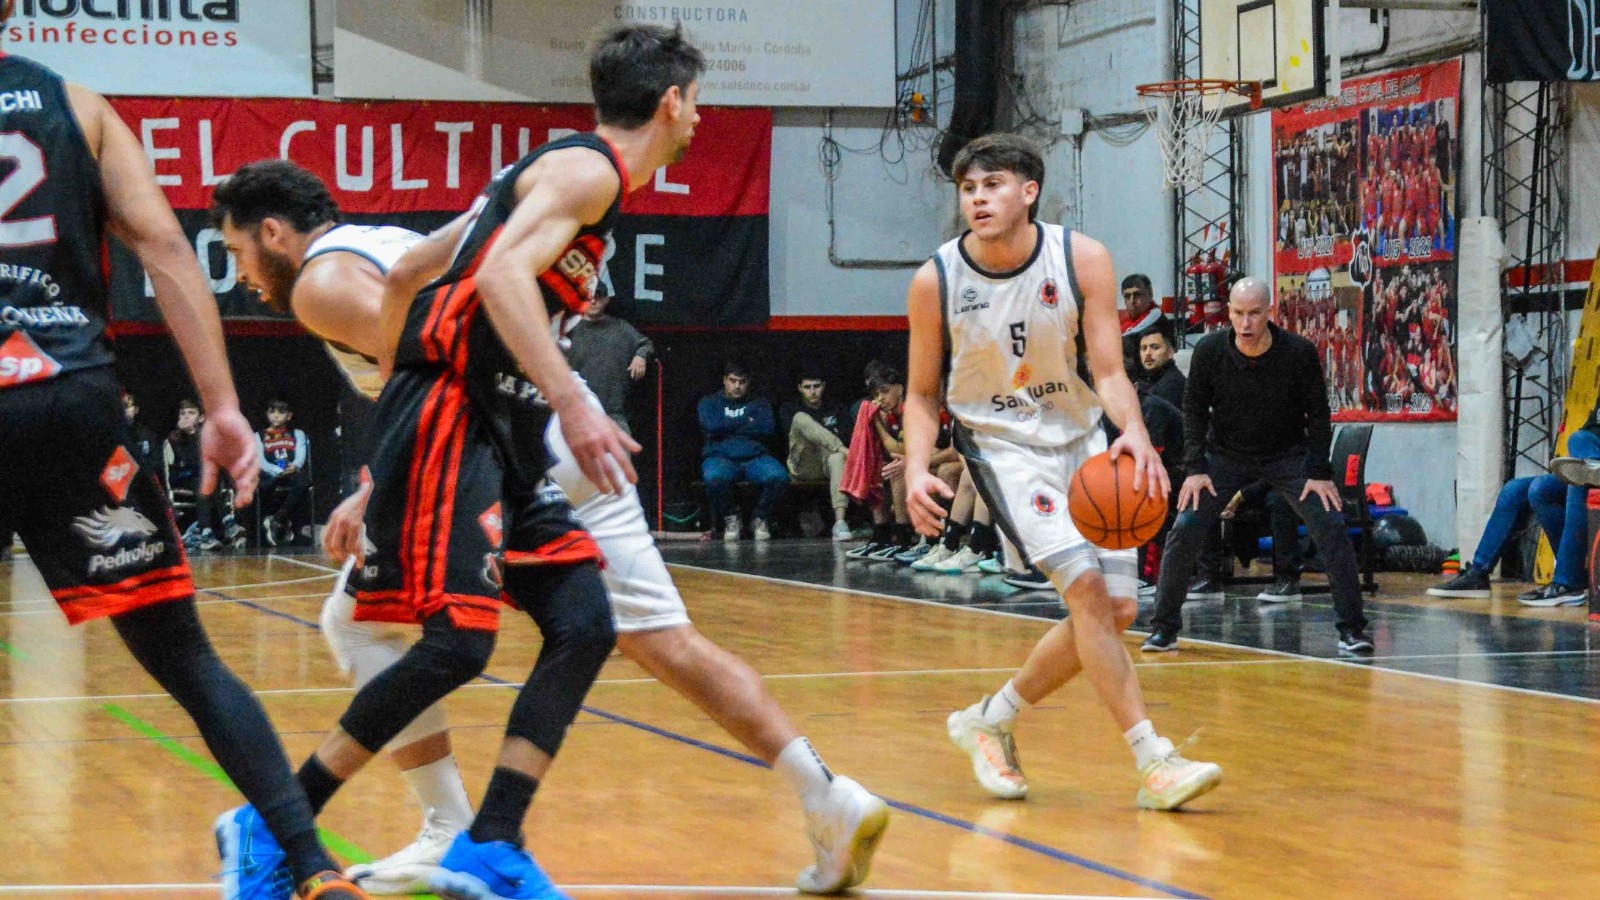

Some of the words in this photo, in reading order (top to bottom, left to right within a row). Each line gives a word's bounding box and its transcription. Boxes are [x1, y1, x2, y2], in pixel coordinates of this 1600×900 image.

[614, 6, 748, 22] CONSTRUCTORA
[9, 21, 238, 46] sinfecciones
[1385, 78, 1399, 98] DE
[1009, 320, 1026, 358] 5
[991, 394, 1029, 412] San
[1027, 381, 1069, 403] Juan
